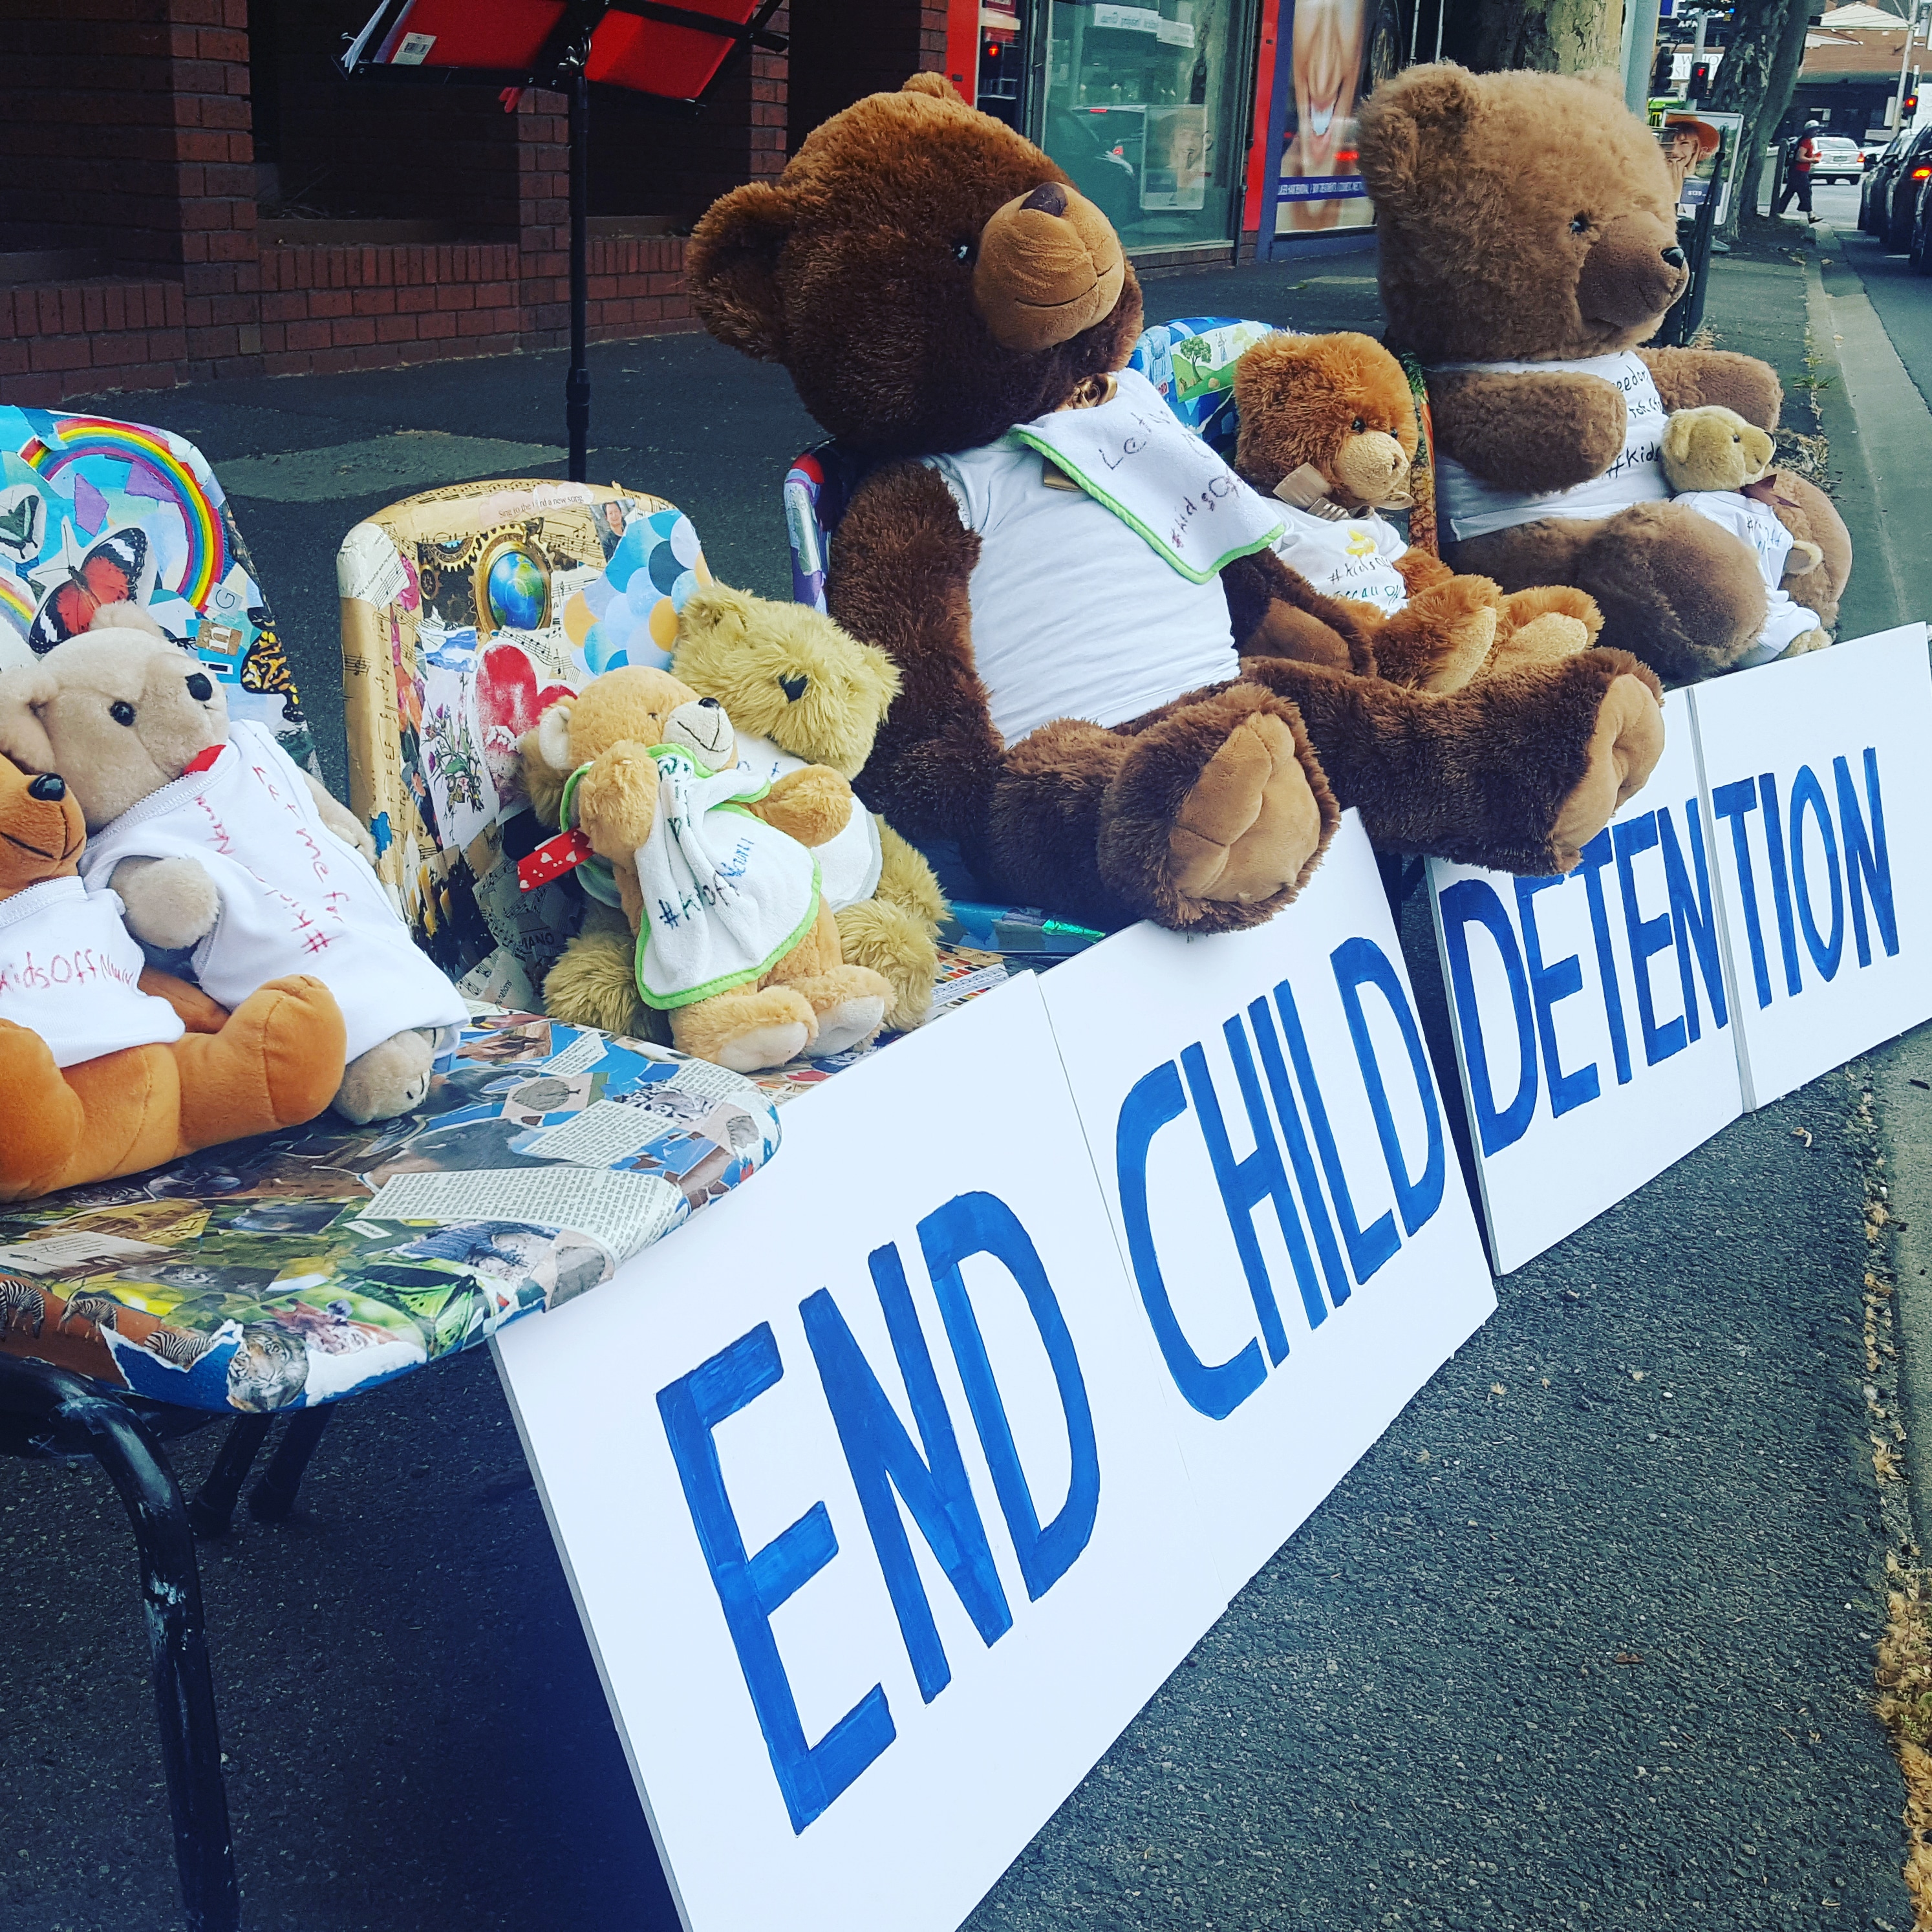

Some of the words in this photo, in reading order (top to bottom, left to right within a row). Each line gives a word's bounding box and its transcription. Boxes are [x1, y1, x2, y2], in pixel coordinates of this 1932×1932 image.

[553, 497, 566, 505] new
[568, 495, 584, 504] song
[656, 1190, 1100, 1837] END
[1116, 936, 1445, 1421] CHILD
[1439, 747, 1900, 1158] DETENTION
